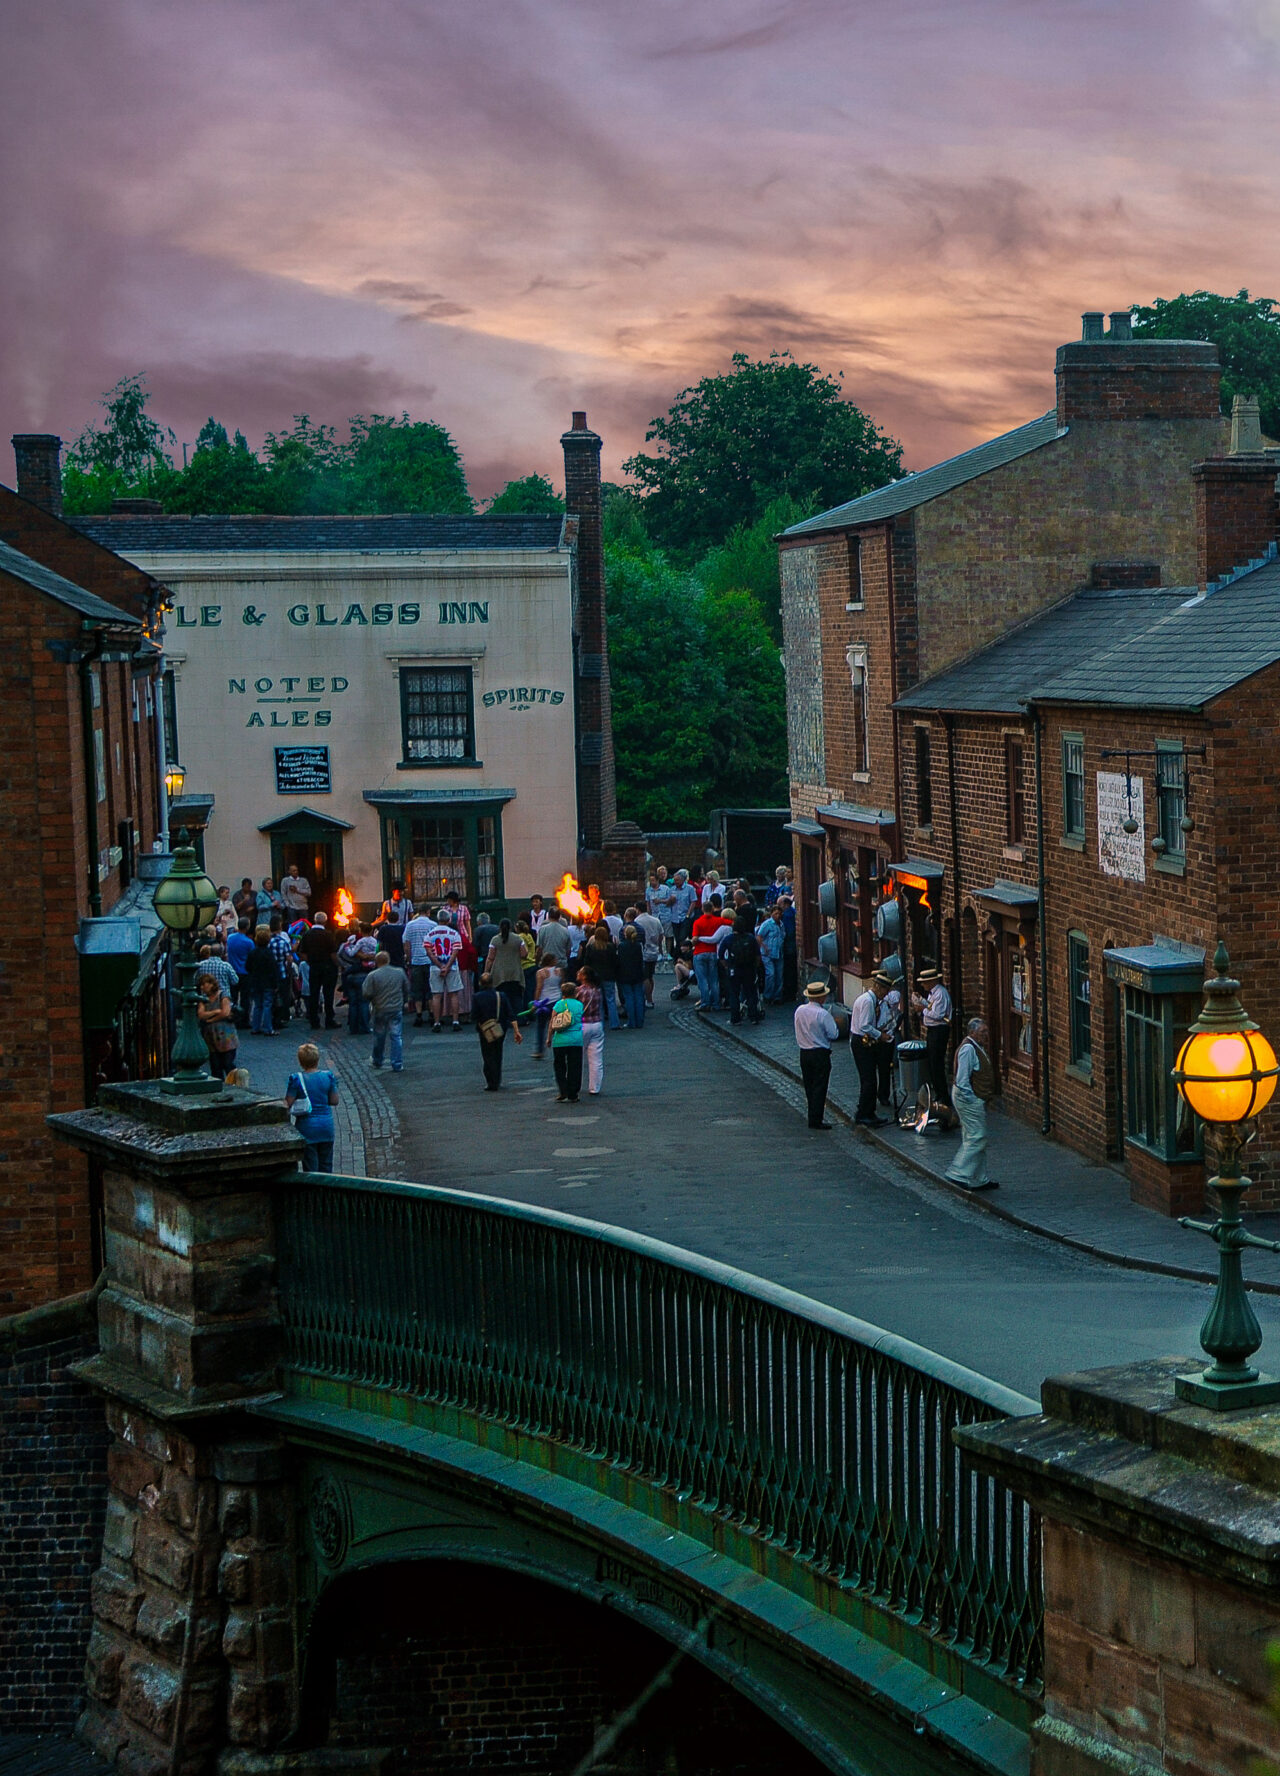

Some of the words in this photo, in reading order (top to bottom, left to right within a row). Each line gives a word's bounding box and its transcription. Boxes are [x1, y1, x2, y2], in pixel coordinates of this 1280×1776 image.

[175, 605, 222, 628] LE
[242, 604, 267, 627] &
[286, 602, 421, 627] GLASS
[438, 601, 490, 625] INN
[228, 676, 350, 694] NOTED
[481, 687, 565, 707] SPIRITS
[245, 710, 333, 728] ALES
